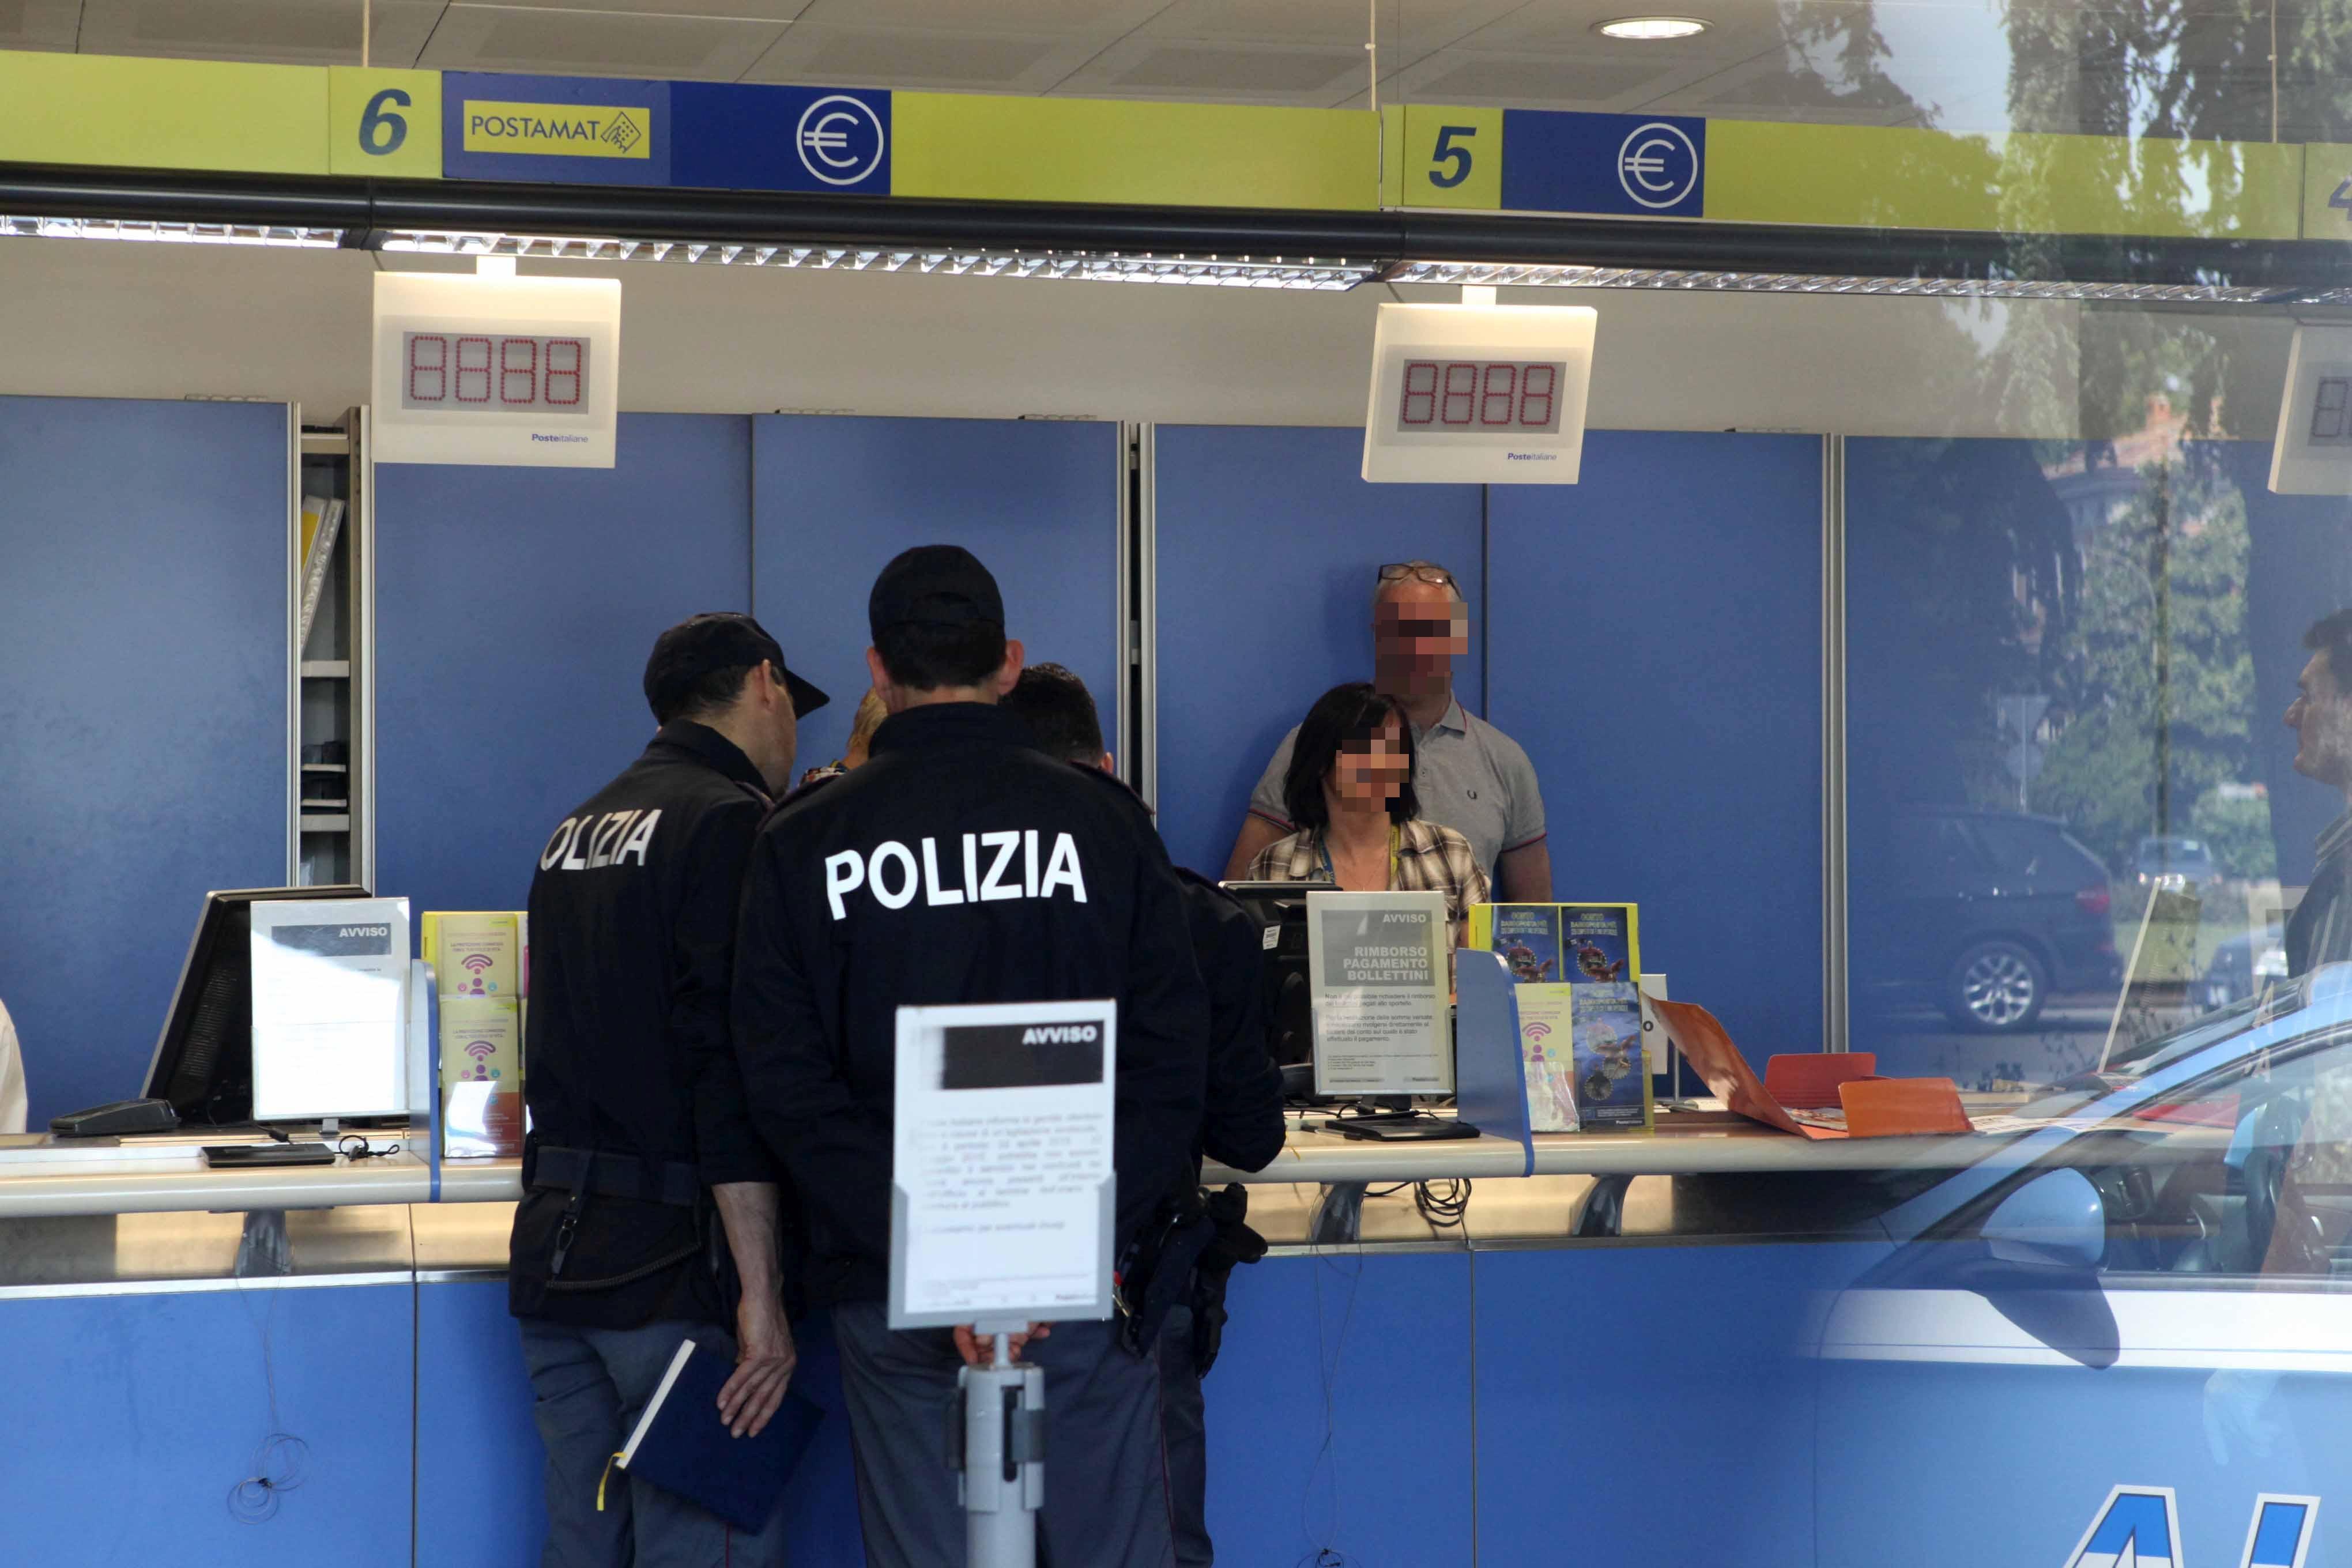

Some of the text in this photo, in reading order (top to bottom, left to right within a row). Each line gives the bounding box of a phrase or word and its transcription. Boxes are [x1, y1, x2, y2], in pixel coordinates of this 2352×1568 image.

[359, 88, 412, 156] 6
[472, 115, 601, 141] POSTAMAT
[1428, 126, 1477, 189] 5
[541, 809, 662, 871] OLIZIA
[825, 830, 1087, 921] POLIZIA
[1382, 913, 1427, 924] AVVISO
[339, 926, 388, 938] AVVISO
[1354, 946, 1427, 957] RIMBORSO
[1343, 958, 1428, 969] PAGAMENTO
[1347, 970, 1428, 981] BOLLETTINI
[1022, 1025, 1097, 1045] AVVISO
